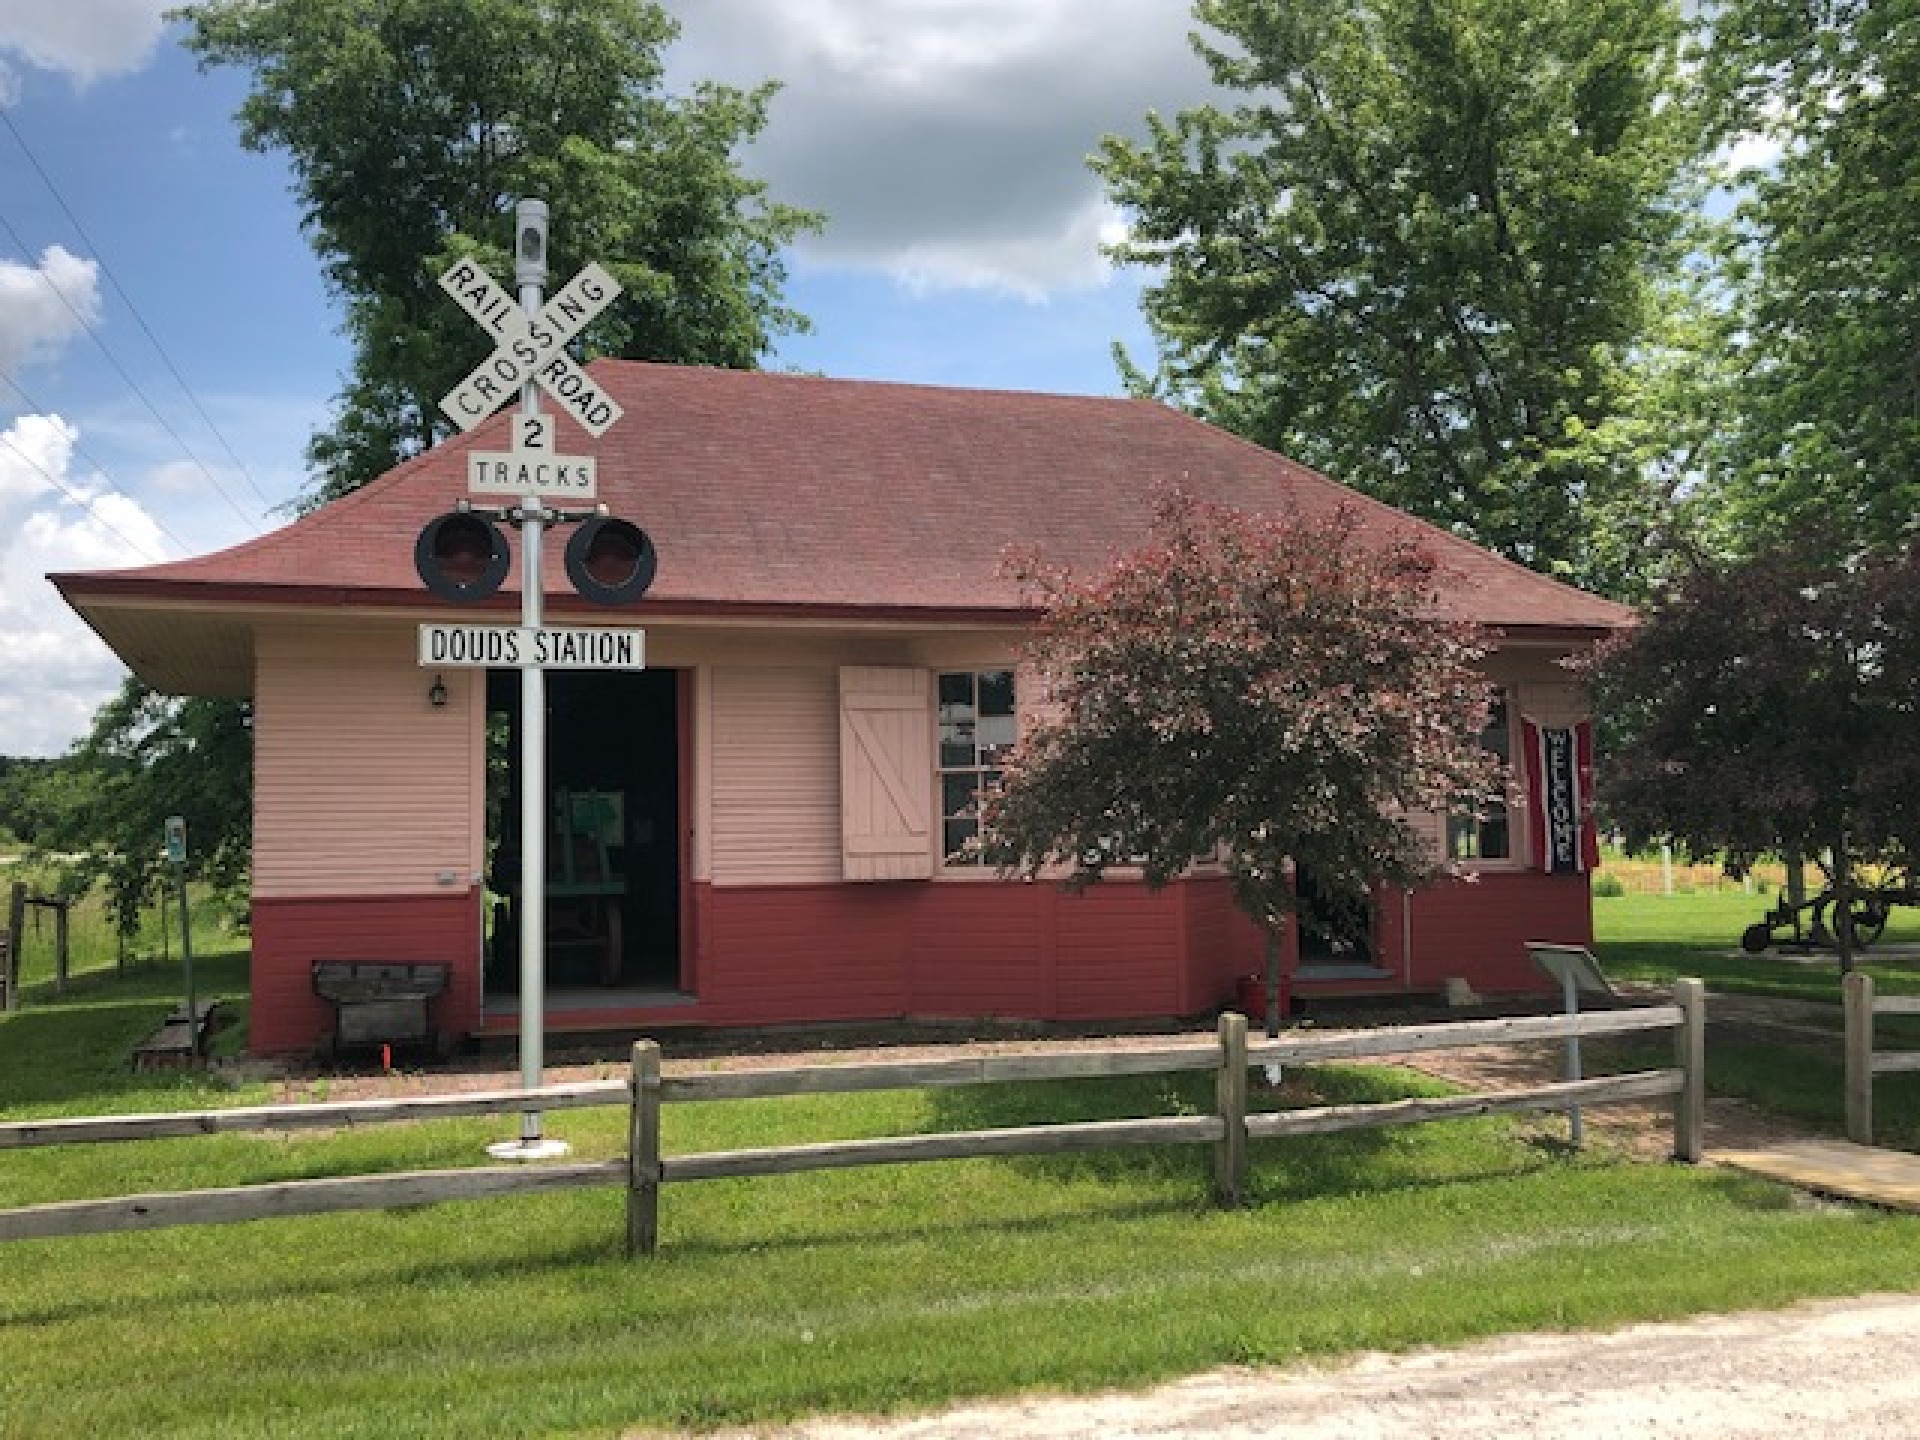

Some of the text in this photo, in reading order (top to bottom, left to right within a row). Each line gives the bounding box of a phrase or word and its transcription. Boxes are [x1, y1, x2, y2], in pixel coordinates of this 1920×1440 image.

[448, 265, 613, 427] RAIL ROAD
[456, 278, 605, 415] CROSSING
[523, 419, 544, 448] 2
[476, 461, 589, 487] TRACKS
[431, 629, 631, 664] DOUDS STATION
